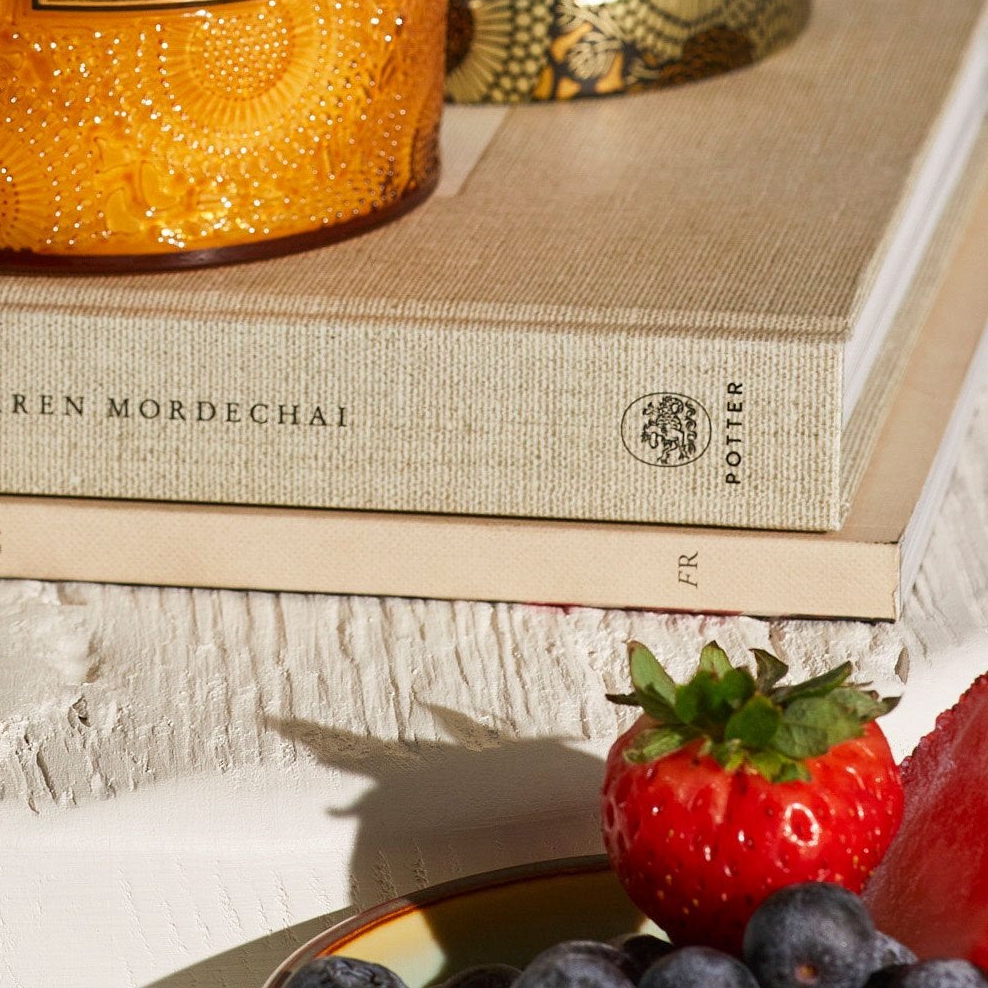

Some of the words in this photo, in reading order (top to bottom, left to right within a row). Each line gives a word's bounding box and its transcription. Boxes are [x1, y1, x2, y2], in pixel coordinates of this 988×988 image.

[108, 396, 349, 428] MORDECHAI
[725, 381, 743, 485] POTTER
[678, 550, 699, 588] FR
